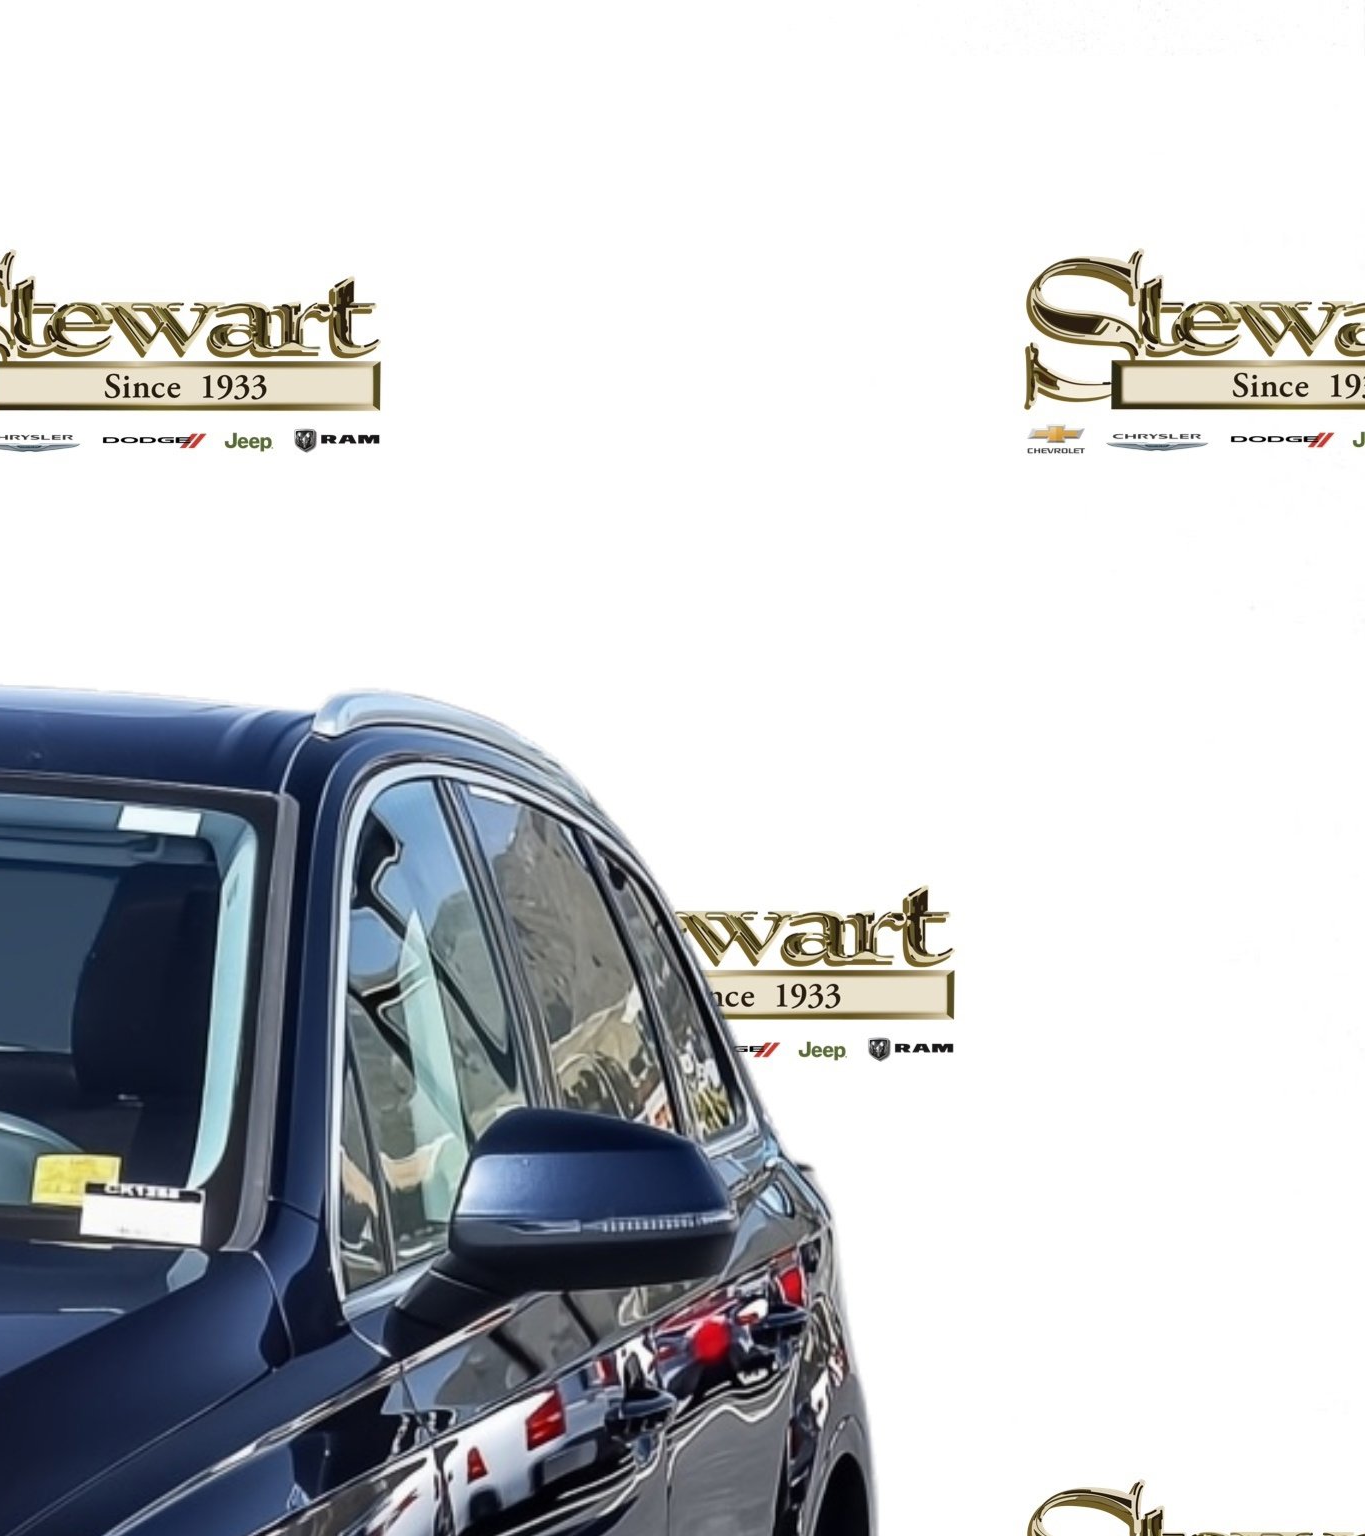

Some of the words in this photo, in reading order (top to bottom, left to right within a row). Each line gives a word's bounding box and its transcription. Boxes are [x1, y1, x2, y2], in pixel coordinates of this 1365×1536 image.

[104, 373, 180, 399] Since
[202, 374, 267, 400] 1933
[1232, 372, 1308, 398] Since
[1330, 373, 1365, 399] 19
[102, 435, 190, 444] DODGE
[224, 432, 273, 452] Jeep
[321, 435, 380, 445] RAM
[1230, 434, 1318, 443] DODGE
[674, 884, 955, 968] wart
[776, 983, 841, 1009] 1933
[798, 1041, 847, 1061] Jeep
[895, 1044, 954, 1054] RAM
